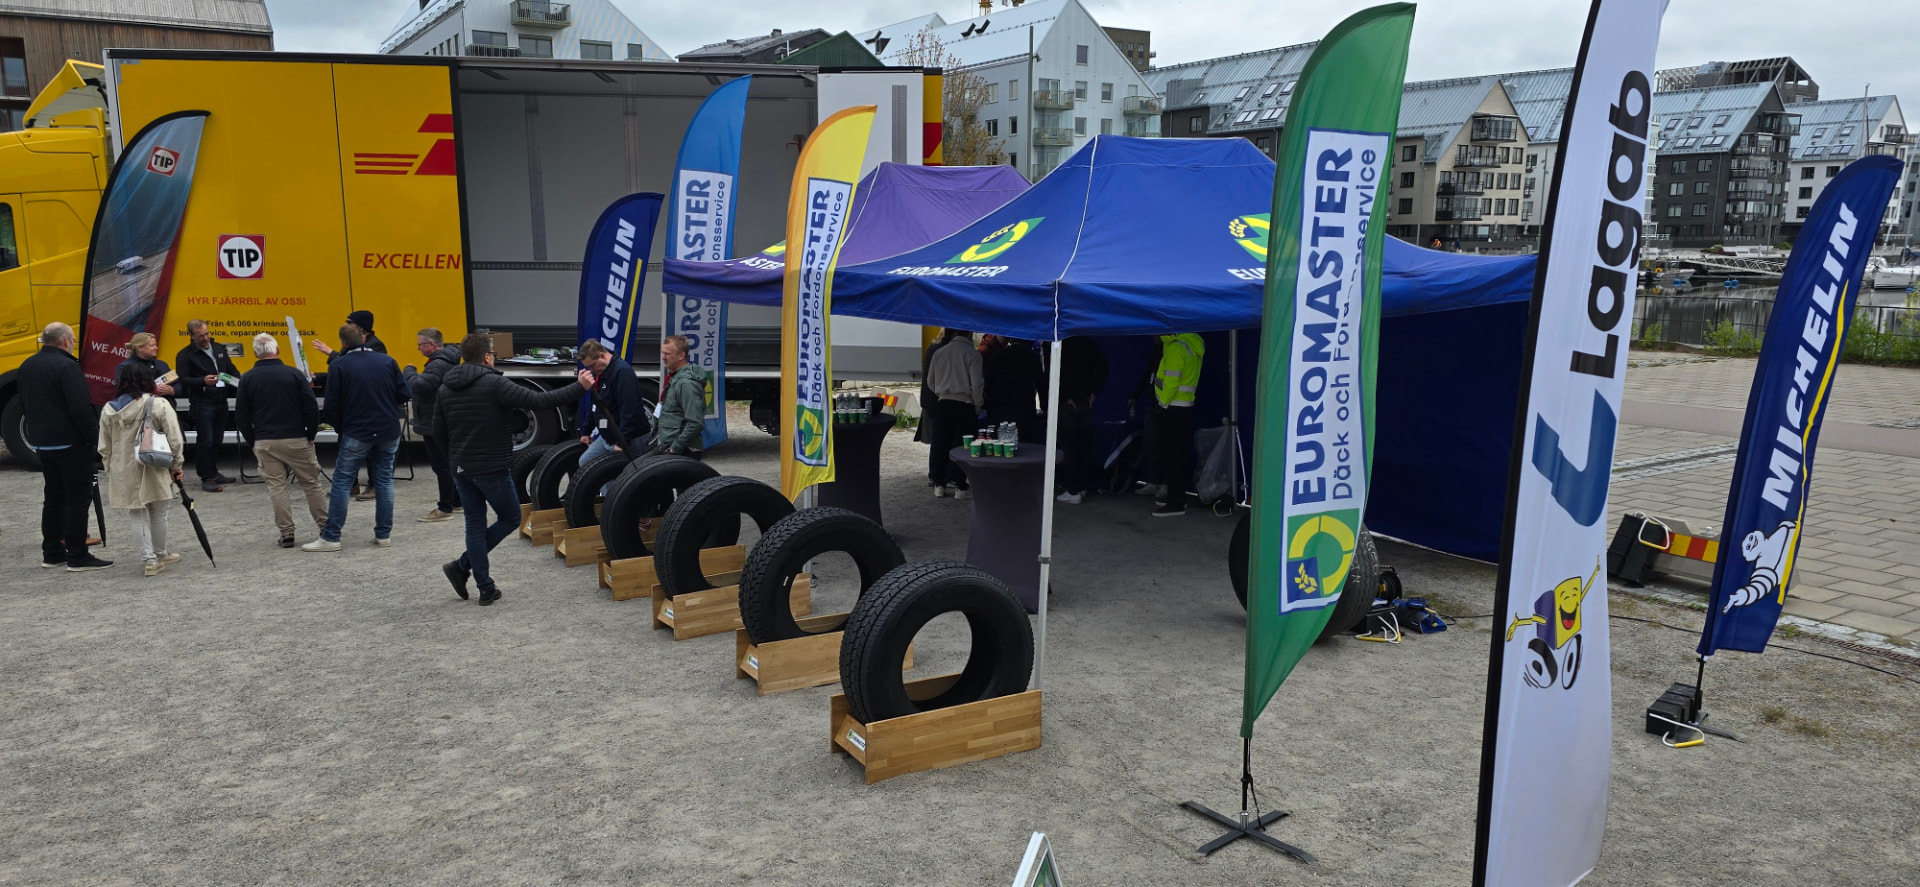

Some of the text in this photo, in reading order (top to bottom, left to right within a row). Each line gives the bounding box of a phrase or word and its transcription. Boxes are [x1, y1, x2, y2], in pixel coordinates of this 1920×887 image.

[153, 154, 174, 169] TIP
[223, 248, 260, 269] TIP
[1569, 70, 1651, 379] Lagab
[187, 295, 307, 306] HYR FJÄRRBIL AV OSS!
[600, 217, 637, 352] ICHELIN
[680, 178, 711, 365] EUROASTER
[704, 180, 725, 367] Däck och onsservice
[811, 191, 844, 403] Däck och Fordonsservice
[887, 265, 1009, 278] EUROMASTER
[91, 340, 109, 353] WE
[226, 320, 251, 328] 45.000
[1291, 148, 1353, 505] EUROMASTER
[1761, 201, 1859, 512] MICHELIN
[1331, 373, 1350, 421] och
[1332, 431, 1353, 500] Däck
